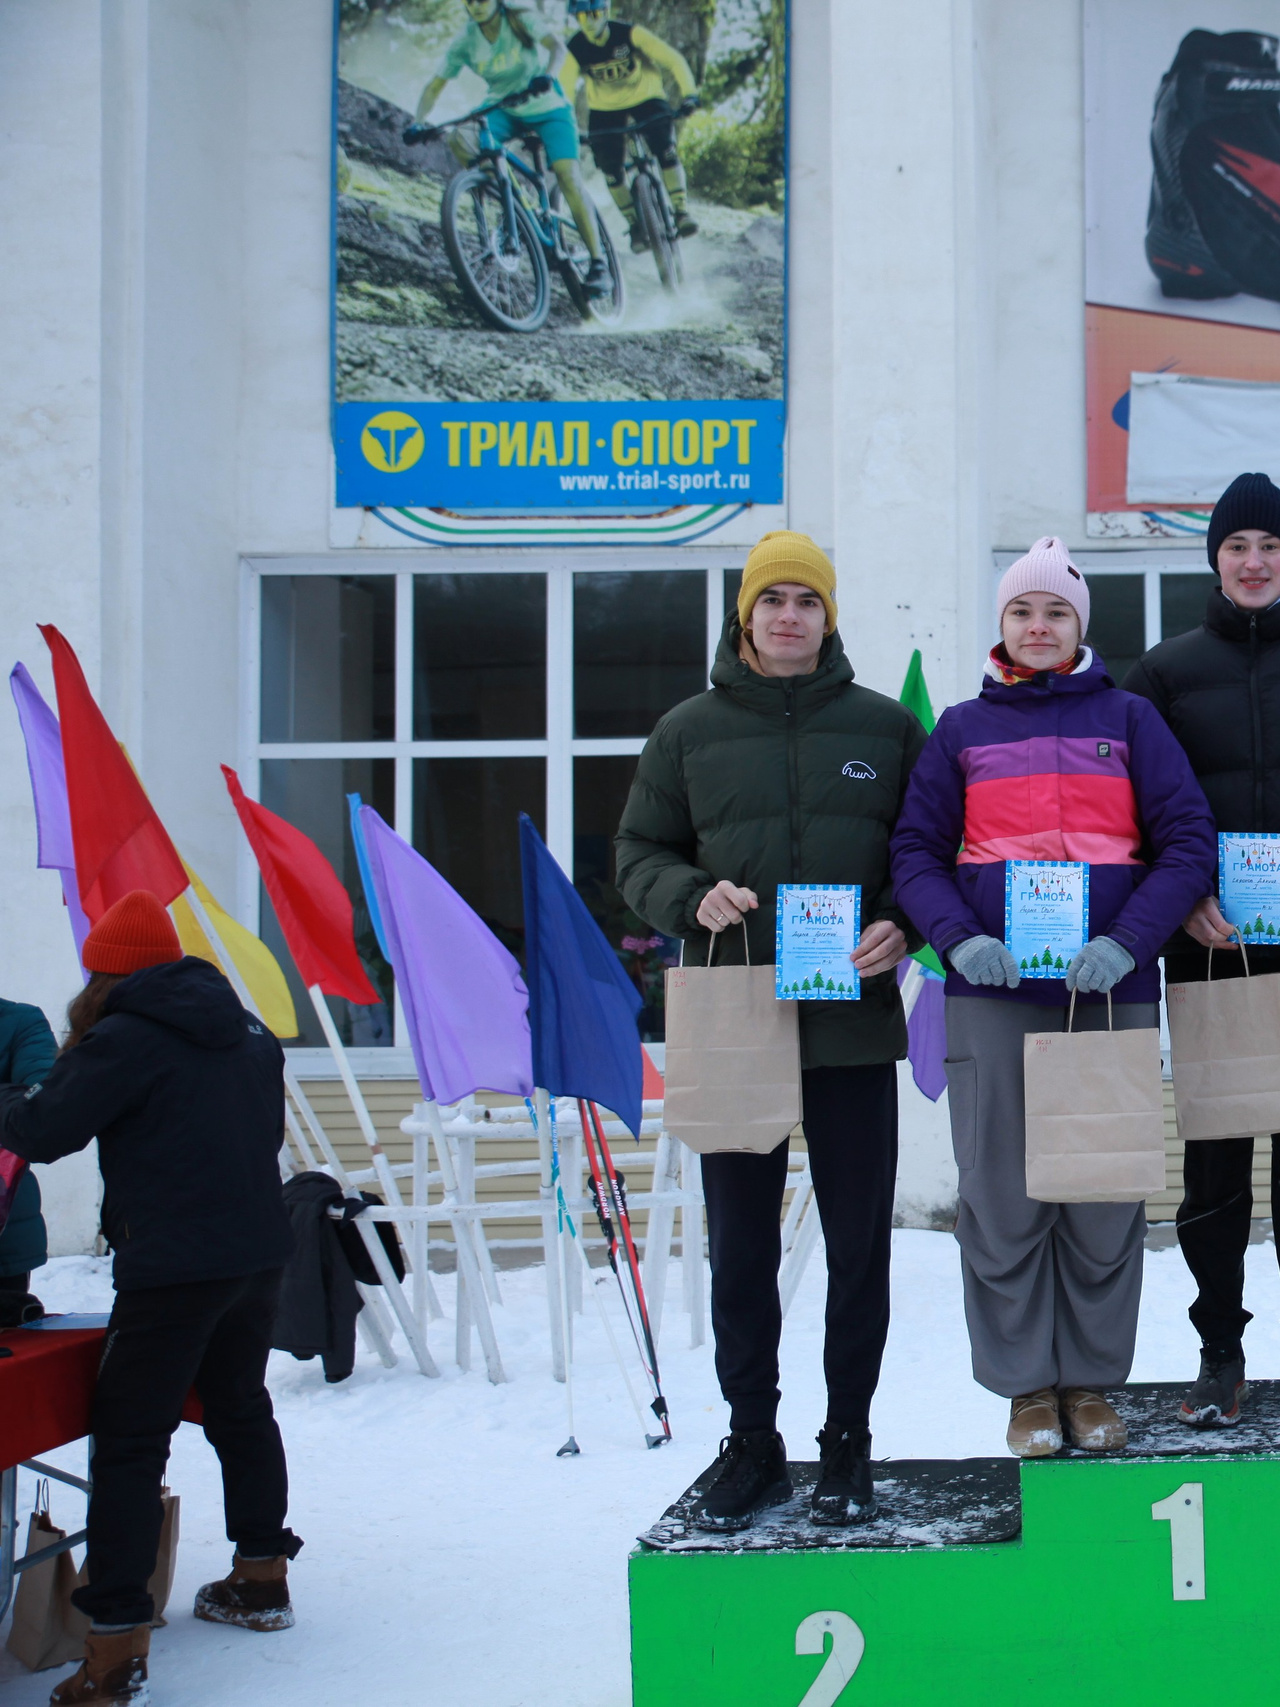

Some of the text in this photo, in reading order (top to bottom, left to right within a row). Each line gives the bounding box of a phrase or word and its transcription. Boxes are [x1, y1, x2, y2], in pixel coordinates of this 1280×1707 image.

[559, 469, 751, 494] www.trial-sport.ru
[1020, 892, 1074, 902] ГРАМОТА
[791, 916, 844, 925] ГРАМОТА
[597, 1181, 611, 1219] NORDWAY
[611, 1179, 626, 1216] NORDWAY
[1151, 1483, 1206, 1602] 1
[795, 1611, 866, 1707] 2
